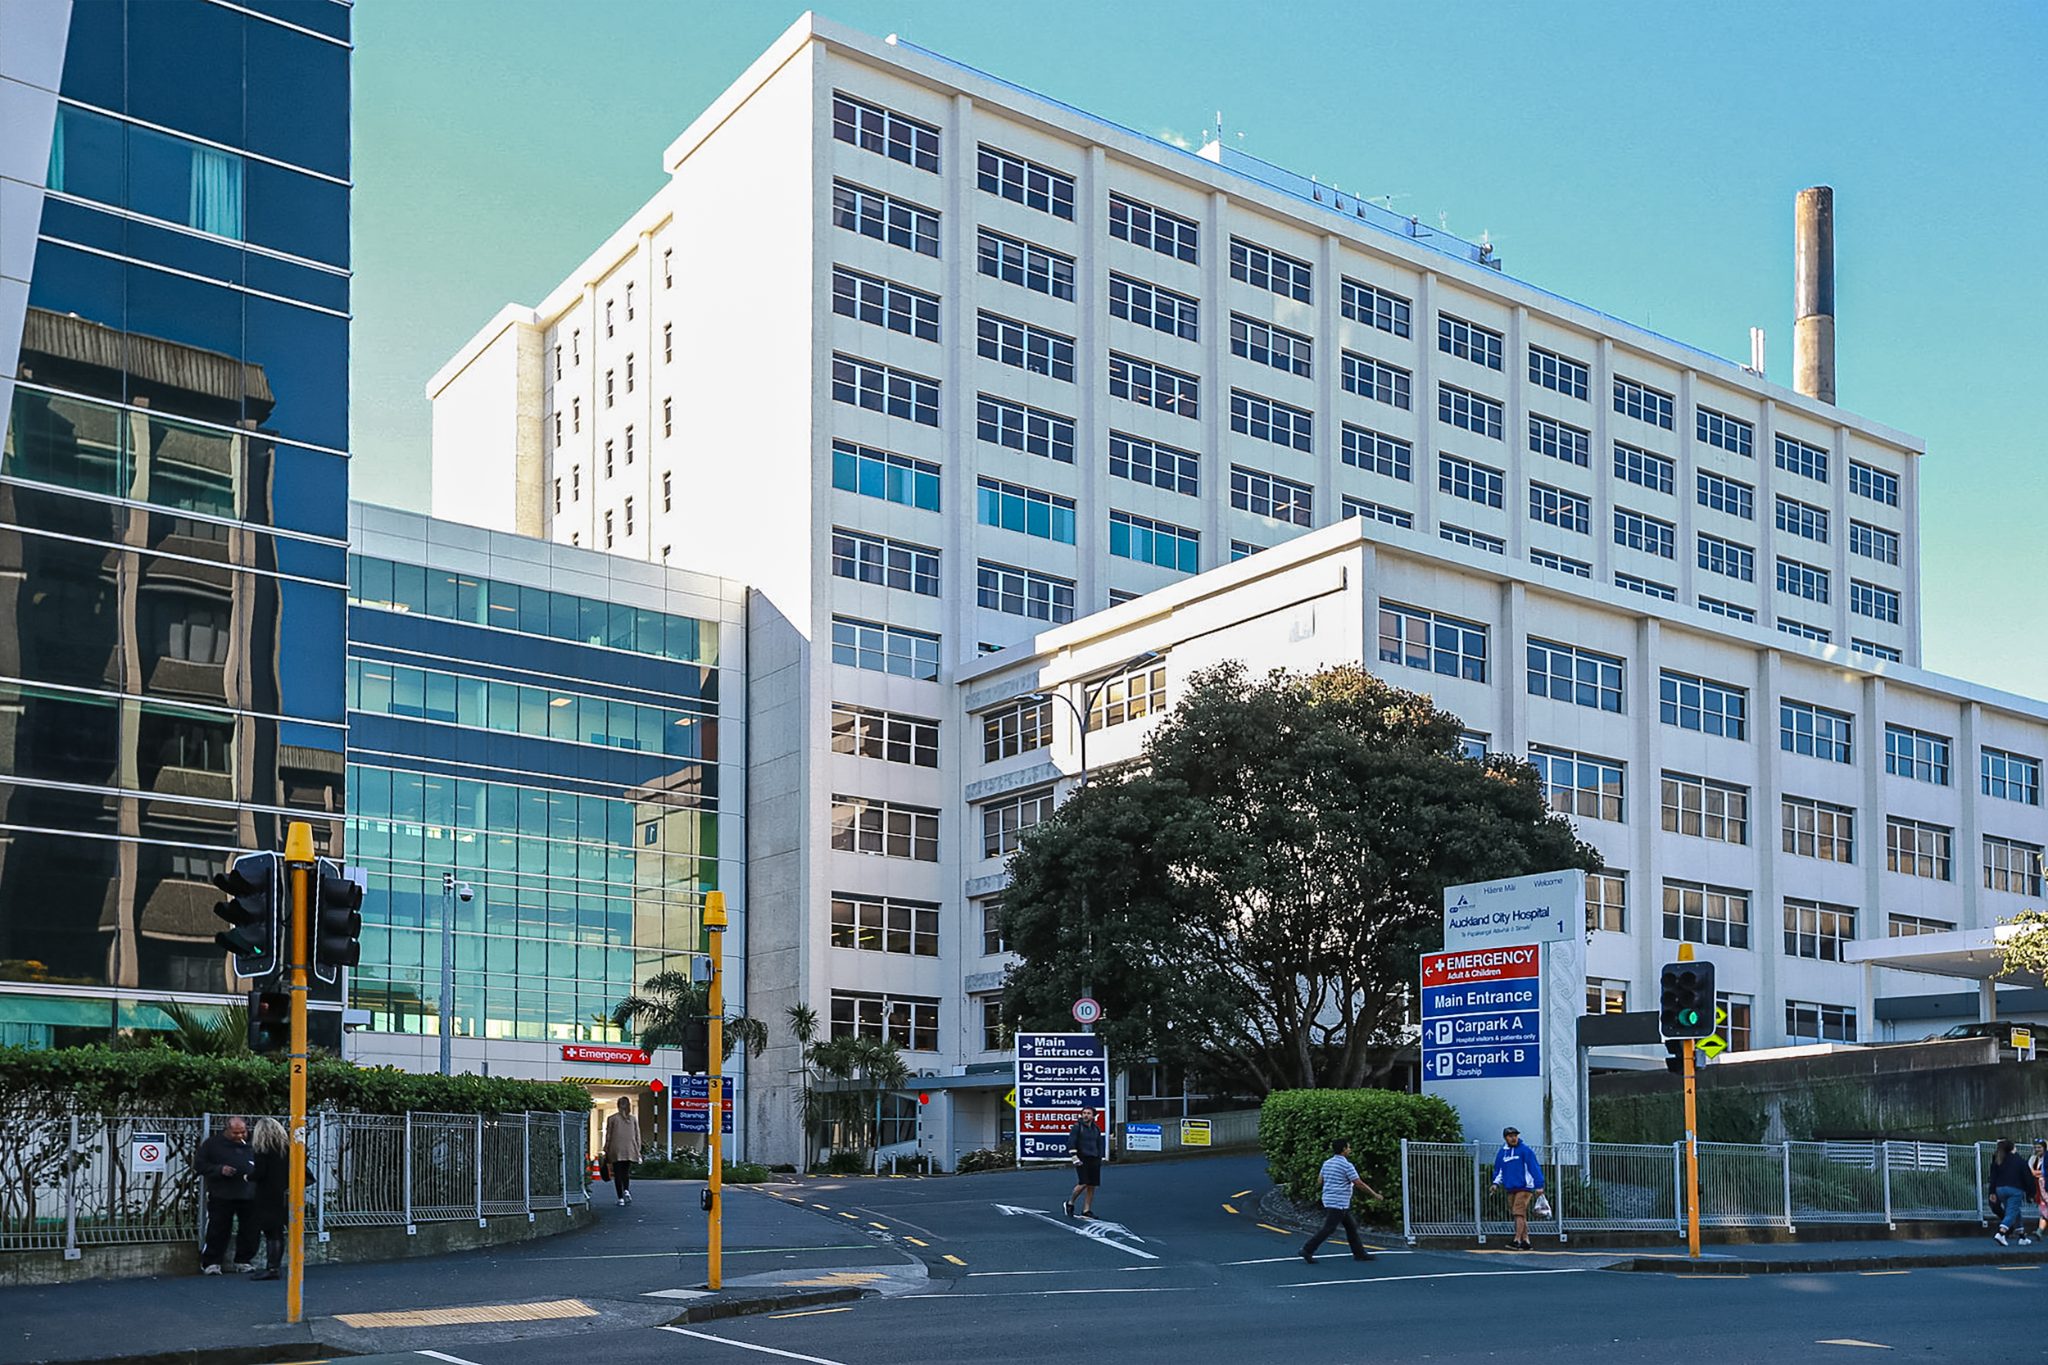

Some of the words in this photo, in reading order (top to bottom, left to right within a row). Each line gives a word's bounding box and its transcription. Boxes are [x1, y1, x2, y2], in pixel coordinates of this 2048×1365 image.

[1534, 878, 1563, 888] Welcome
[1449, 914, 1490, 929] Auckland
[1492, 912, 1510, 925] City
[1512, 906, 1550, 921] Hospital
[1557, 920, 1563, 933] 1
[1446, 949, 1534, 971] EMERGENCY
[1447, 971, 1464, 980] Adult
[1464, 970, 1470, 978] &
[1471, 968, 1501, 978] Children
[1435, 993, 1463, 1009] Main
[1467, 990, 1532, 1006] Entrance
[1080, 1006, 1092, 1016] 10
[1455, 1016, 1509, 1035] Carpark
[1511, 1016, 1523, 1030] A
[1034, 1037, 1065, 1047] Main
[1500, 1034, 1522, 1042] patients
[1523, 1033, 1536, 1041] only
[579, 1048, 633, 1062] Emergency
[1034, 1047, 1094, 1056] Entrance
[1456, 1049, 1509, 1067] Carpark
[1514, 1049, 1525, 1062] B
[294, 1064, 302, 1074] 2
[1034, 1065, 1087, 1076] Carpark
[1090, 1065, 1100, 1075] A
[1456, 1068, 1482, 1076] Starship
[711, 1080, 718, 1088] 3
[1034, 1087, 1087, 1098] Carpark
[1090, 1087, 1100, 1096] B
[680, 1111, 706, 1119] Starship
[1035, 1113, 1100, 1121] EMERGEY
[680, 1123, 705, 1131] Through
[1036, 1142, 1067, 1153] Drop
